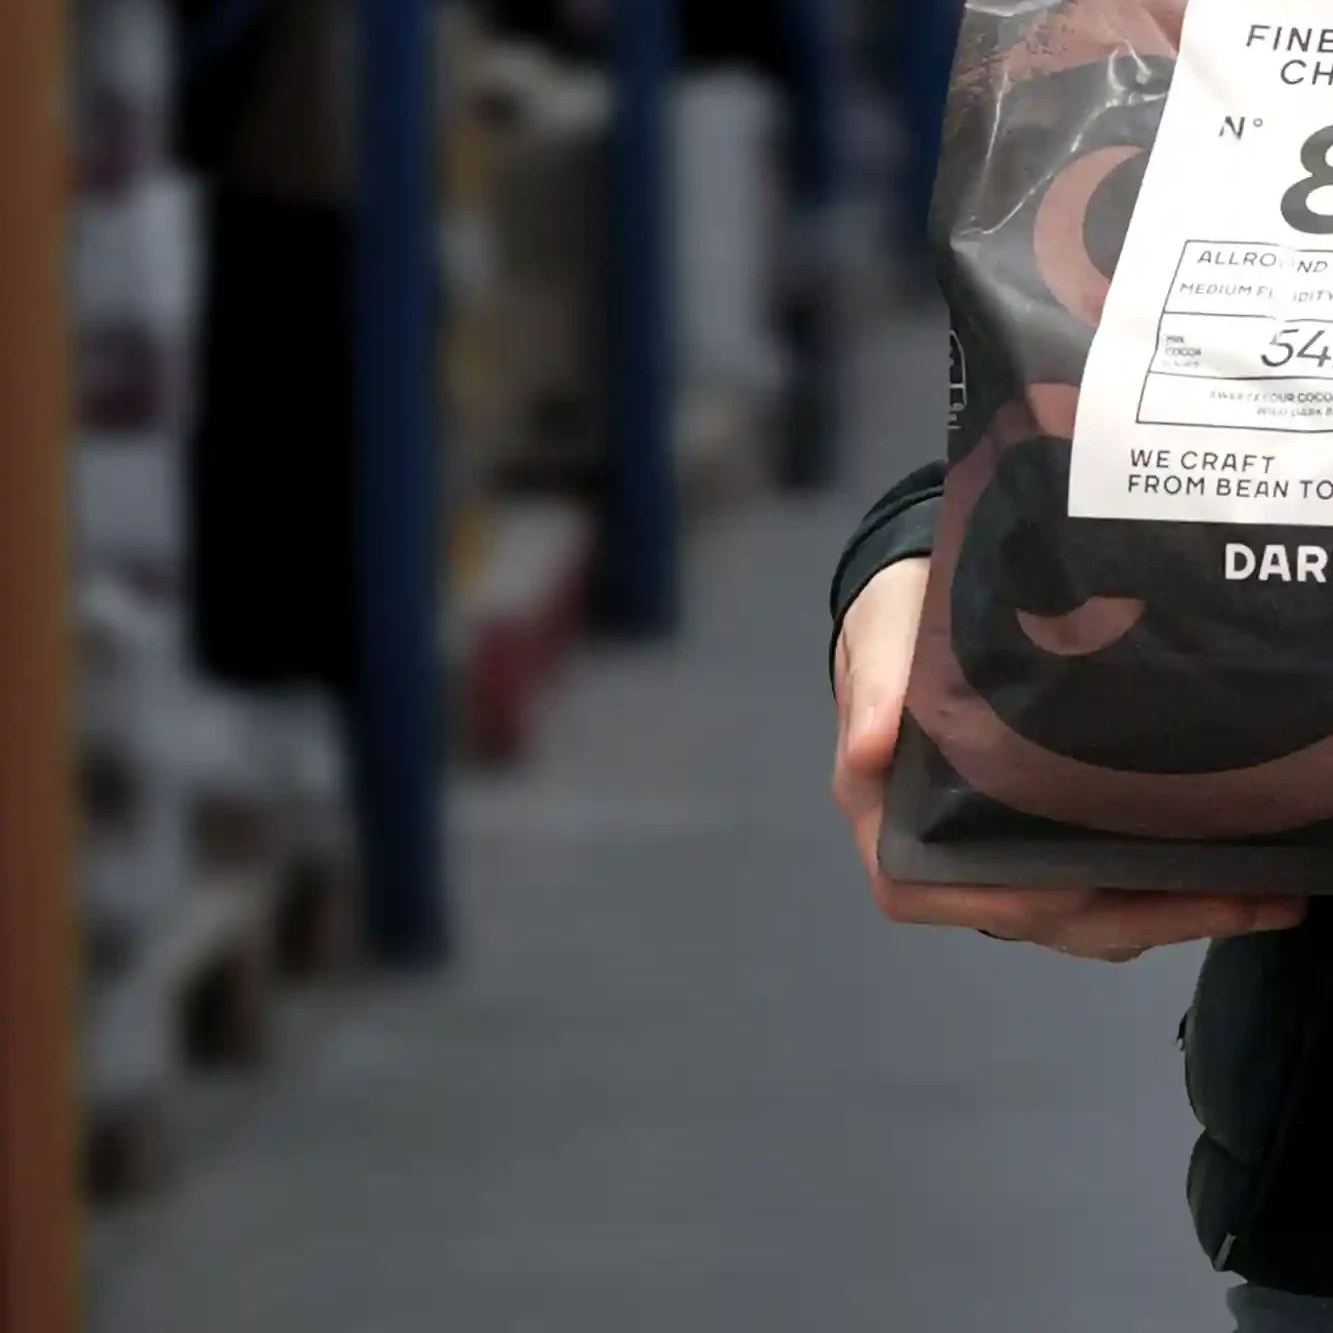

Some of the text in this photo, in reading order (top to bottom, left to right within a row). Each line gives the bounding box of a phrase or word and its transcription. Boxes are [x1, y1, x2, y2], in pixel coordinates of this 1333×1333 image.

[1180, 283, 1252, 296] MEDIUM
[1130, 449, 1275, 474] WE CRAFT
[1128, 474, 1206, 496] FROM
[1216, 479, 1288, 498] BEAN
